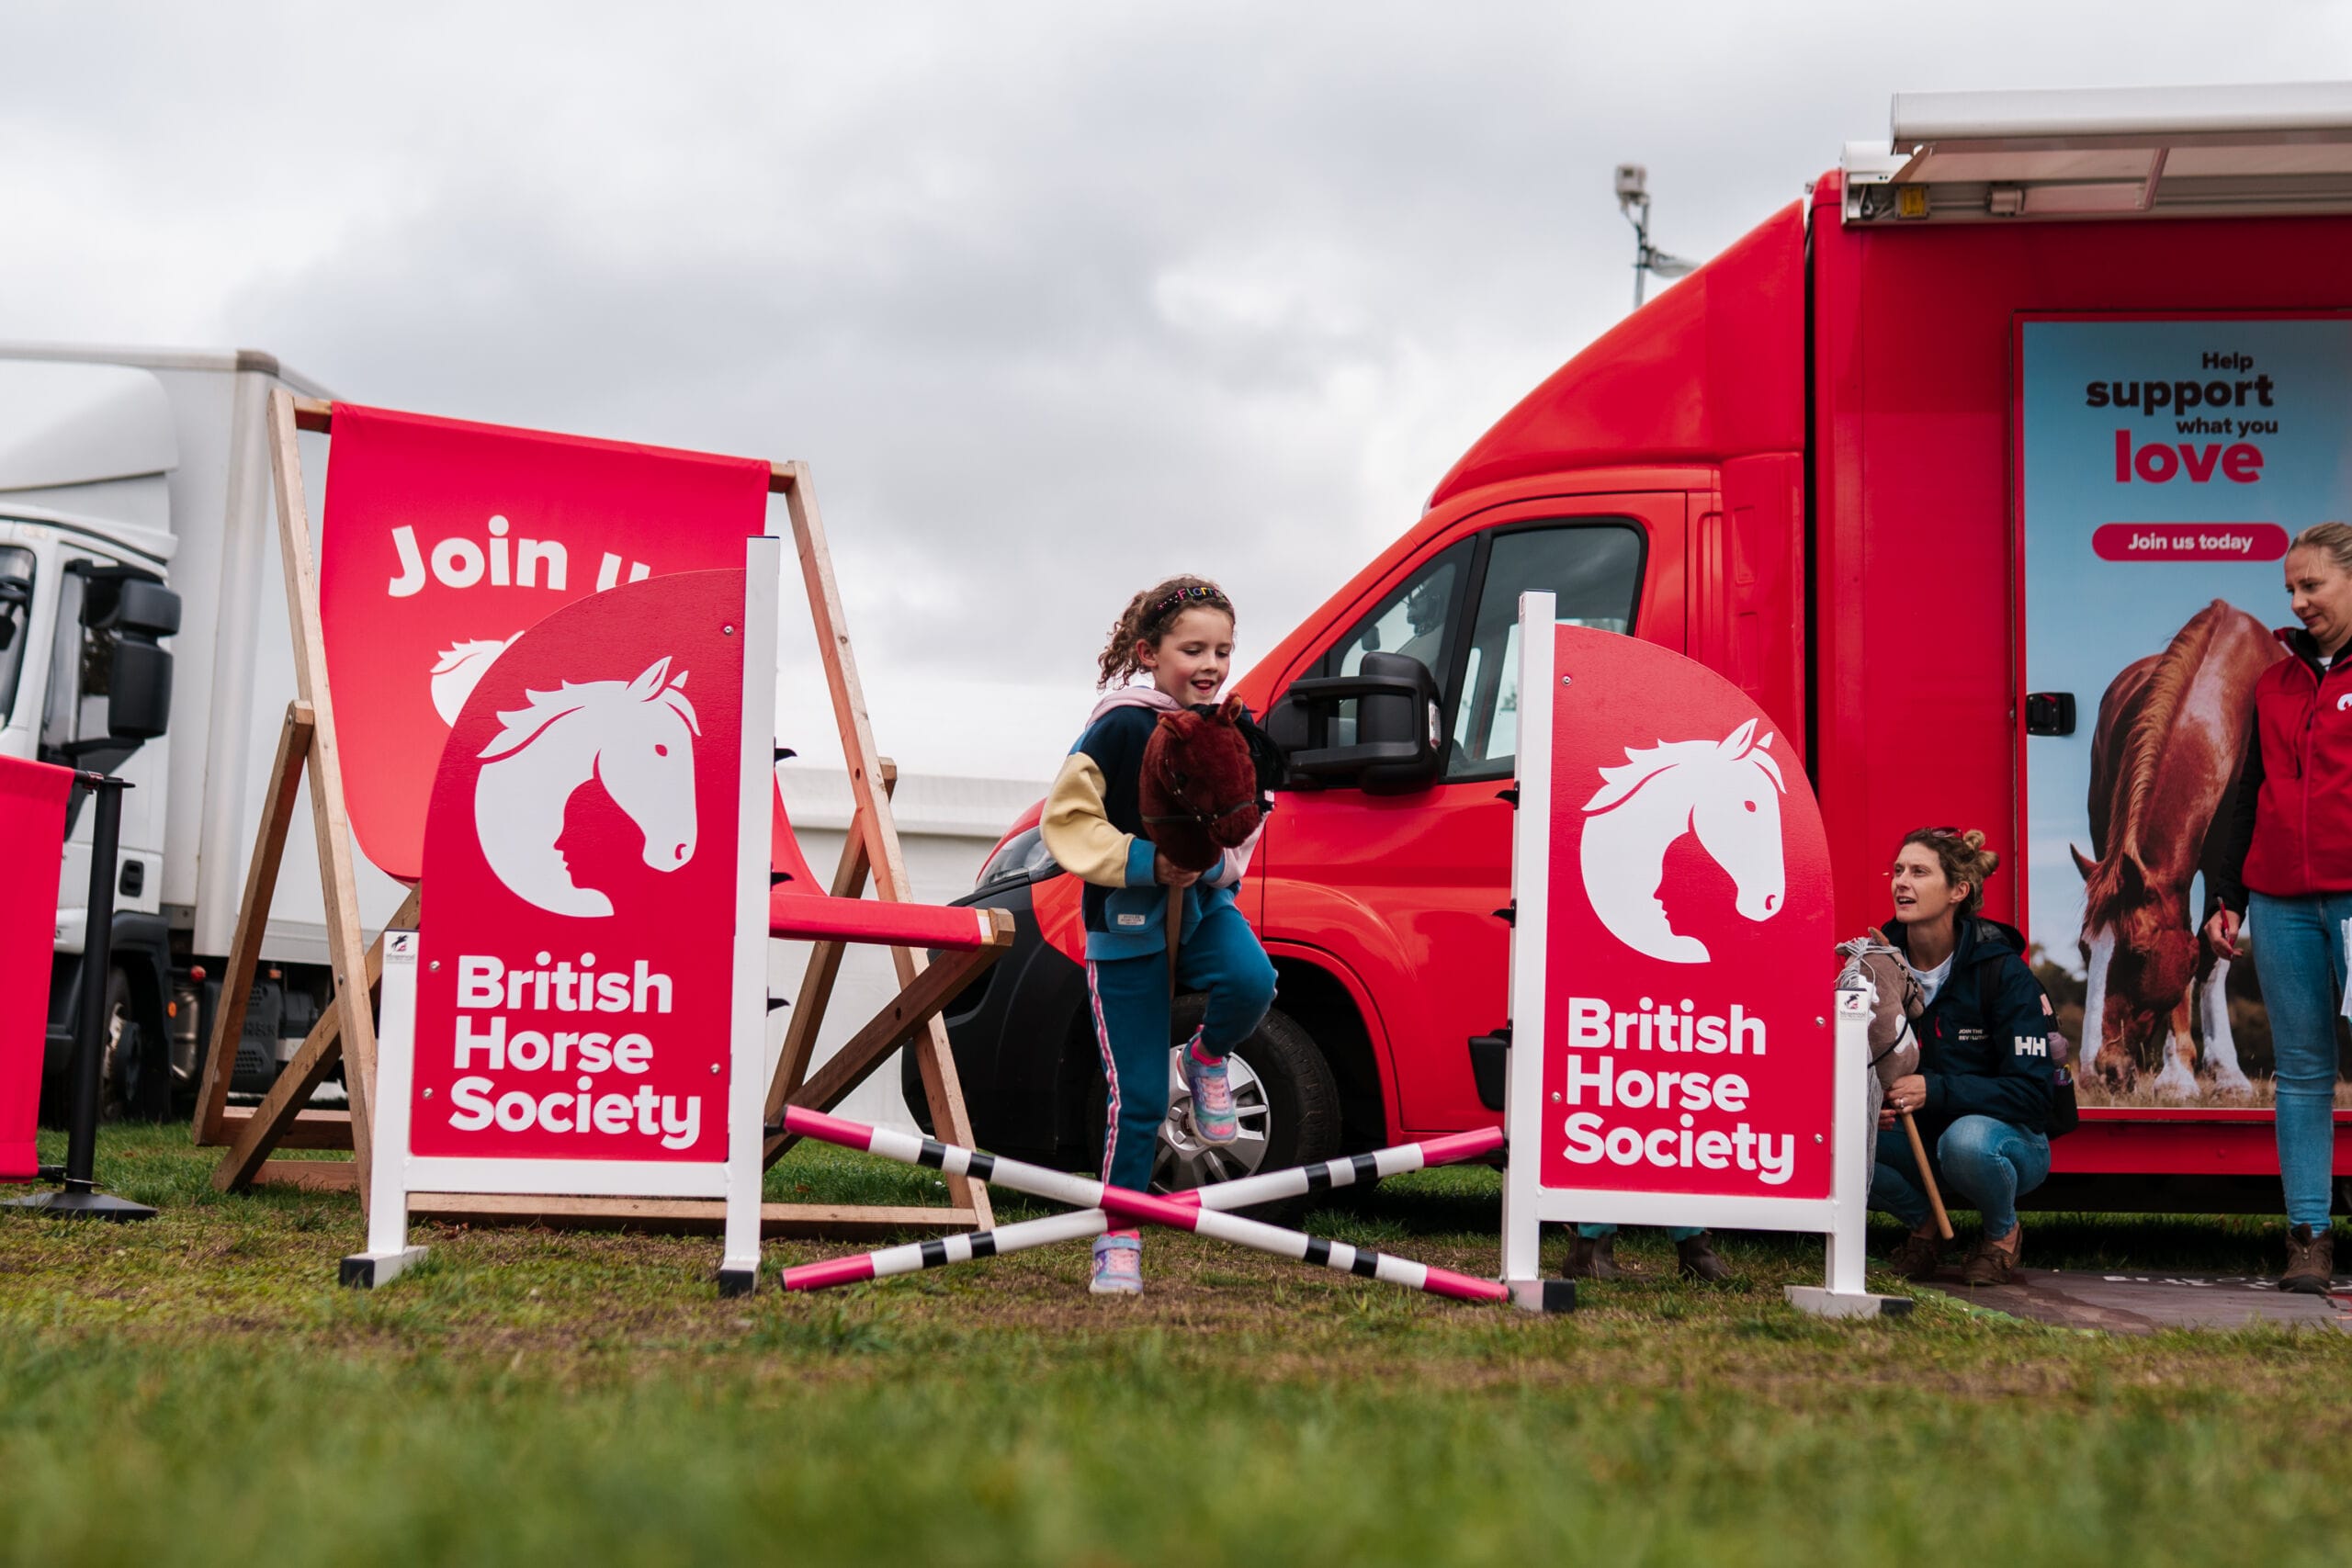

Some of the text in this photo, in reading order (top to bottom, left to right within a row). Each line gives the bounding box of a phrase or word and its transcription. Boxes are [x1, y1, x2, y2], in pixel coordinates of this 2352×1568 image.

[2202, 352, 2255, 373] Help
[2086, 374, 2275, 416] support
[2115, 429, 2265, 484] love
[2176, 417, 2279, 438] what you
[388, 514, 569, 598] Join
[2128, 532, 2254, 554] Join us today
[457, 951, 673, 1013] British
[454, 1015, 654, 1075] Horse
[1567, 996, 1767, 1055] British
[2014, 1035, 2047, 1057] HH
[1566, 1054, 1750, 1112] Horse
[447, 1075, 701, 1150] Society
[1563, 1111, 1795, 1185] Society
